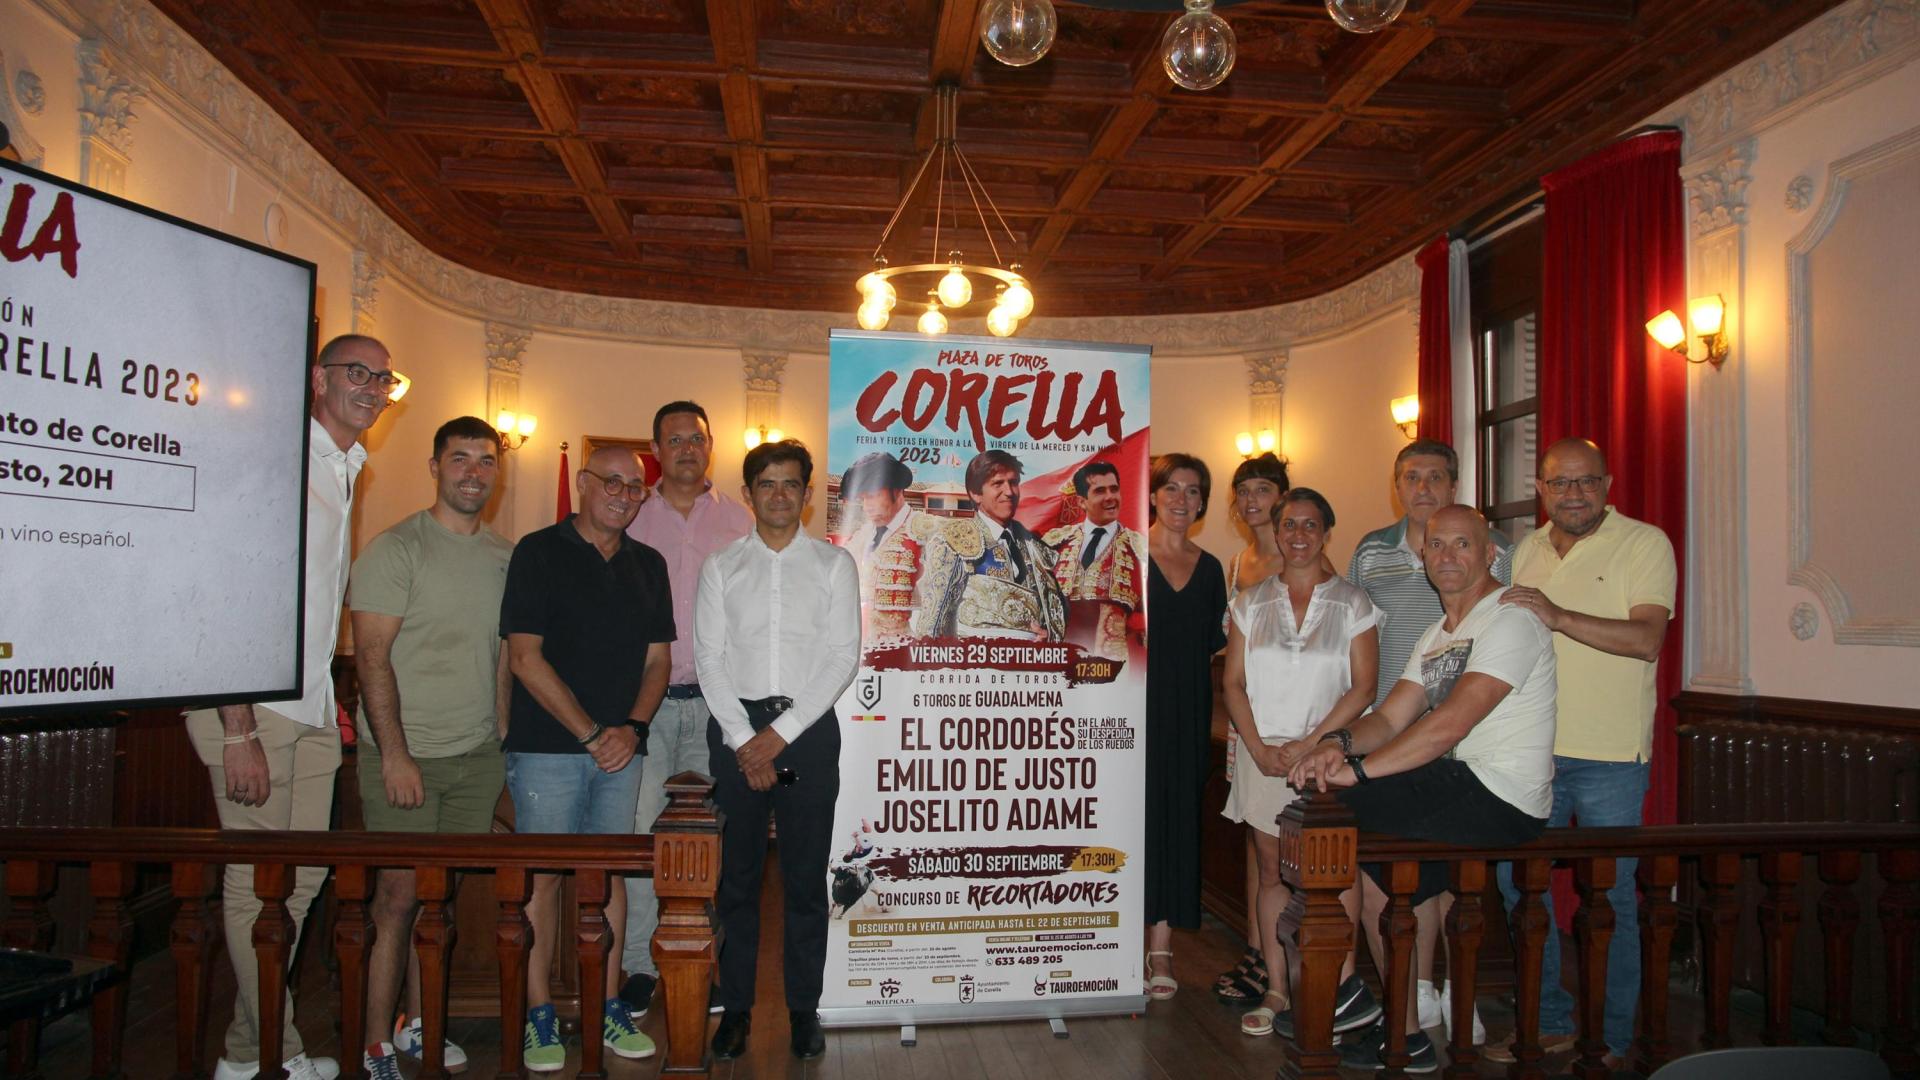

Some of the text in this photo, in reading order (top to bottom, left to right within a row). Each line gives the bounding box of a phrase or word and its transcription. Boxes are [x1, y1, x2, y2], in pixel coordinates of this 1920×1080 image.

[937, 350, 1049, 371] PLAZA DE TOROS
[121, 359, 200, 406] 2023
[856, 368, 1125, 452] CORELLA
[47, 418, 83, 442] de
[92, 425, 181, 456] Corella
[856, 436, 877, 444] FERIA
[880, 436, 885, 444] Y
[887, 436, 916, 446] FIESTAS
[918, 437, 928, 446] EN
[930, 439, 953, 447] HONOR
[990, 441, 1017, 449] VIRGEN
[1020, 442, 1028, 450] DE
[1031, 442, 1040, 450] LA
[1042, 443, 1071, 452] MERCED
[1081, 444, 1095, 453] SAN
[900, 447, 941, 464] 2023
[58, 464, 113, 490] 20H
[11, 525, 53, 542] vino
[59, 531, 135, 548] español.
[909, 644, 1068, 664] VIERNES 29 SEPTIEMBRE
[920, 674, 1059, 684] CORRIDA DE TOROS
[1075, 663, 1111, 677] 17:30H
[913, 691, 1063, 707] 6 TOROS DE GUADALMENA
[901, 711, 1076, 751] EL CORDOBÉS
[1078, 716, 1127, 727] EN EL AÑO DE
[1078, 728, 1133, 739] SU DESPEDIDA
[1078, 740, 1134, 749] DE LOS RUEDOS
[877, 757, 1097, 792] EMILIO DE JUSTO
[874, 797, 1098, 833] JOSELITO ADAME
[908, 853, 1065, 875] SÁBADO 30 SEPTIEMBRE
[1080, 853, 1116, 867] 17:30H
[877, 881, 1119, 911] CONCURSO DE RECORTADORES
[856, 915, 1111, 934] DESCUENTO EN VENTA ANTICIPADA HASTA EL 22 DE SEPTIEMBRE
[986, 942, 1119, 955] www.tauroemocion.com
[995, 955, 1063, 966] 633 489 205
[1050, 977, 1118, 994] TAUROEMOCIÓN
